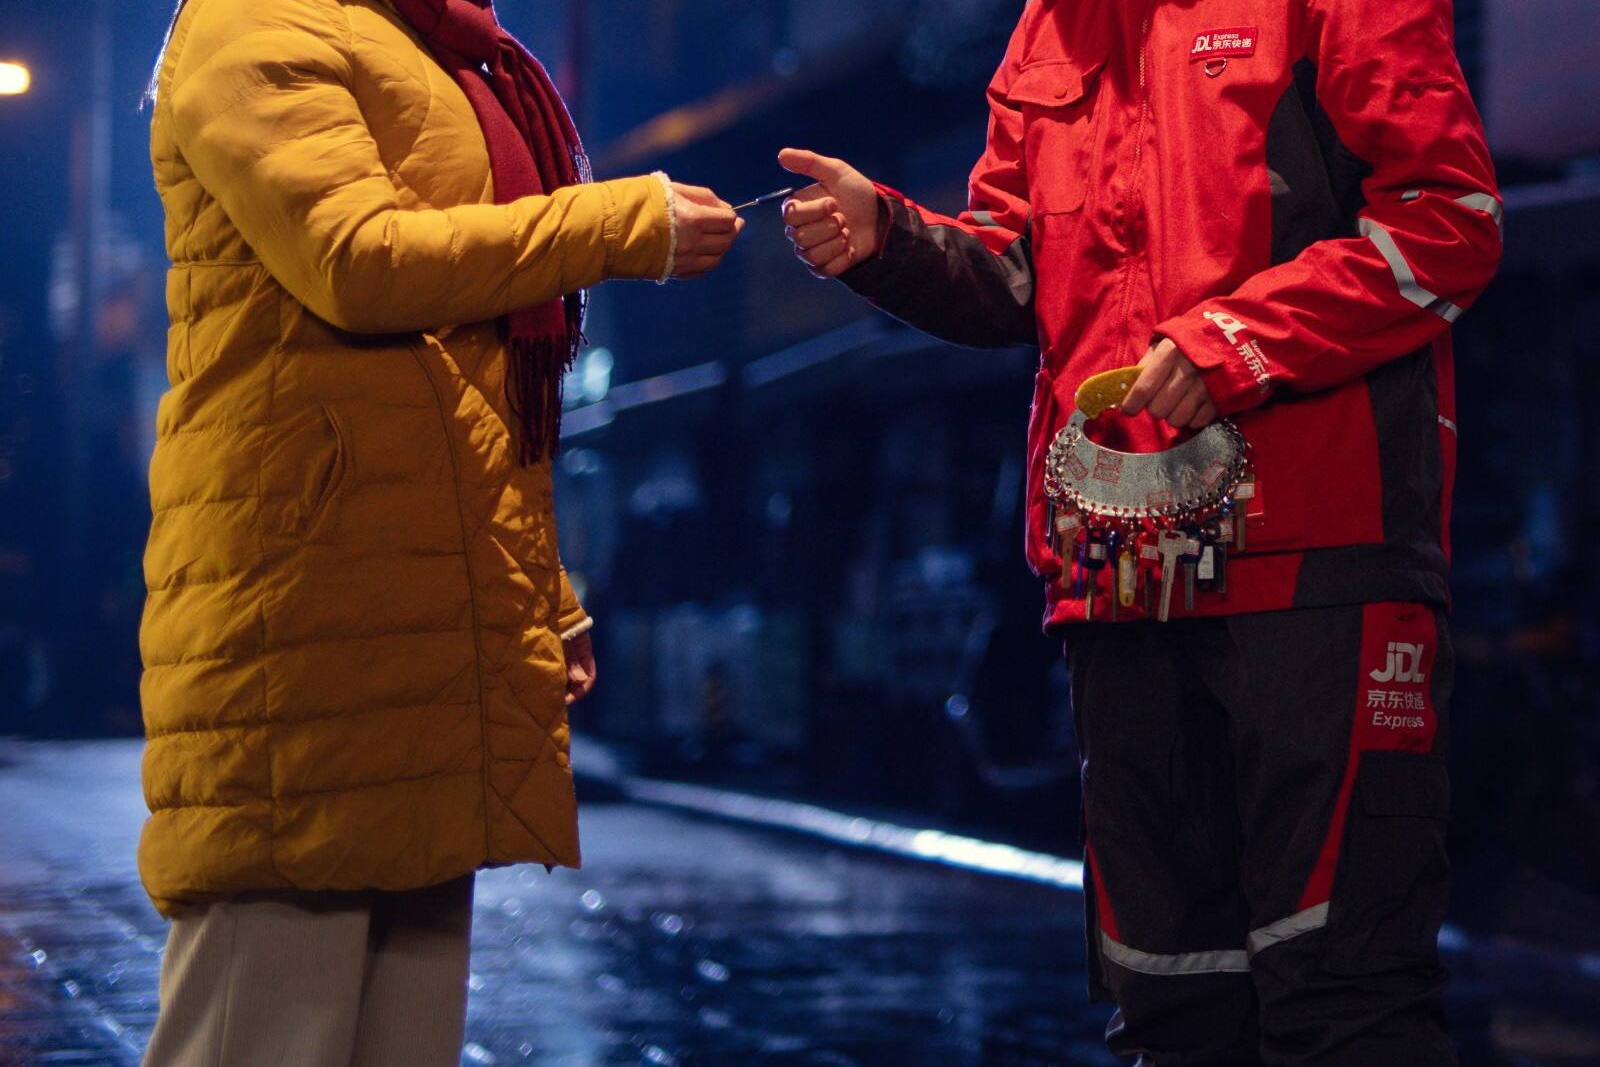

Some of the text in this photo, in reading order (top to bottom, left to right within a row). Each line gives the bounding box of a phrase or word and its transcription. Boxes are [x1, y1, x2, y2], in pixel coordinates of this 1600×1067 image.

[1192, 35, 1212, 53] JDL
[1213, 38, 1252, 50] 京东快递
[1203, 311, 1248, 345] JDL
[1368, 640, 1425, 684] JDL
[1371, 710, 1425, 730] Express
